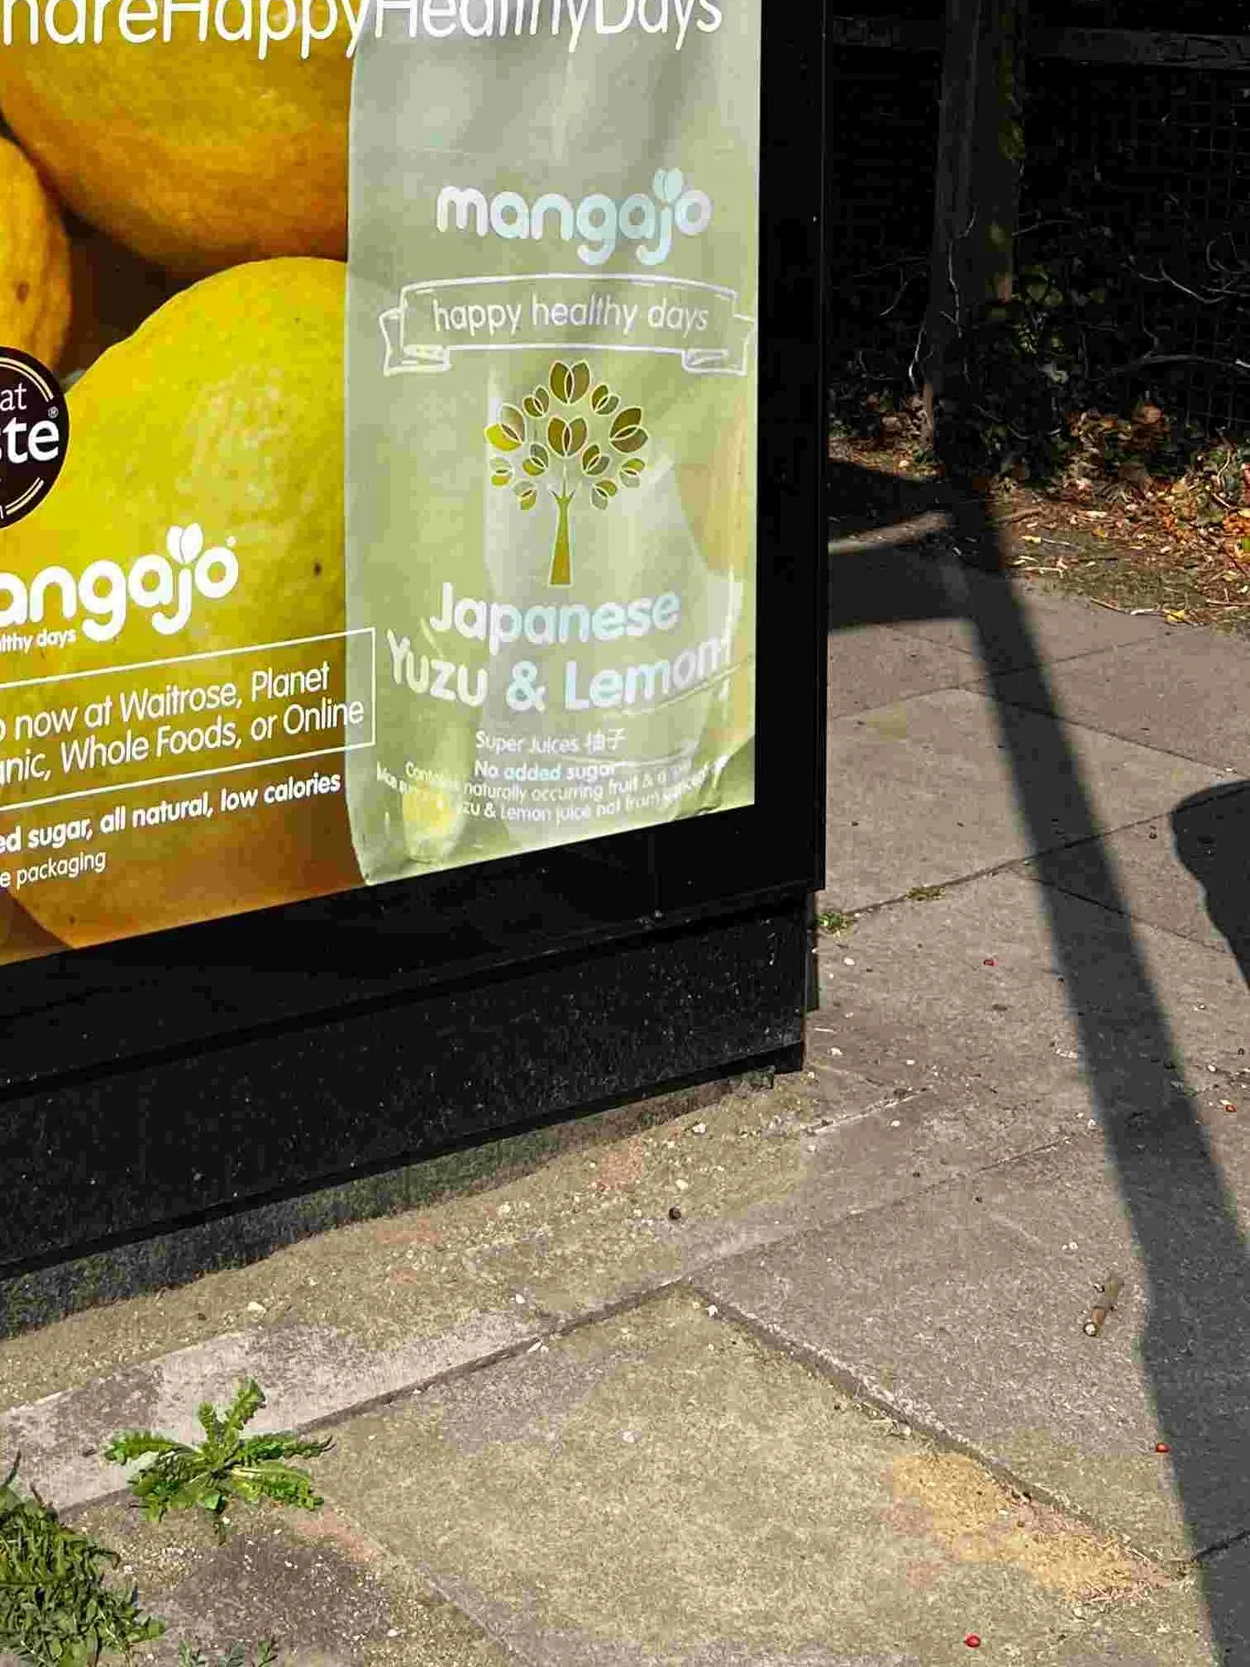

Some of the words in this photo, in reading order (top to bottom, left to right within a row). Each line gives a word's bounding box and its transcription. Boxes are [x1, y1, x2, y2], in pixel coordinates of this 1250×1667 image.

[436, 167, 714, 266] mangajo
[432, 295, 523, 339] happy
[531, 290, 640, 337] healthy
[647, 297, 711, 340] days
[36, 628, 77, 650] days
[429, 581, 681, 656] Japanese
[15, 706, 79, 741] now
[84, 694, 113, 728] at
[120, 681, 243, 723] Waitrose,
[251, 660, 330, 703] Planet
[385, 628, 489, 708] Yuzu
[505, 660, 547, 714] &
[564, 635, 725, 711] Lemon
[61, 729, 149, 774] Whole
[156, 715, 242, 759] Foods,
[250, 713, 278, 741] or
[283, 698, 365, 736] Online
[475, 730, 523, 755] Super
[463, 780, 526, 804] naturally
[474, 759, 499, 779] No
[503, 761, 562, 782] added
[566, 763, 617, 784] sugar
[28, 818, 93, 850] sugar,
[100, 805, 126, 834] all
[132, 791, 214, 828] natural,
[220, 787, 259, 812] low
[263, 772, 341, 805] calories
[16, 851, 107, 890] packaging
